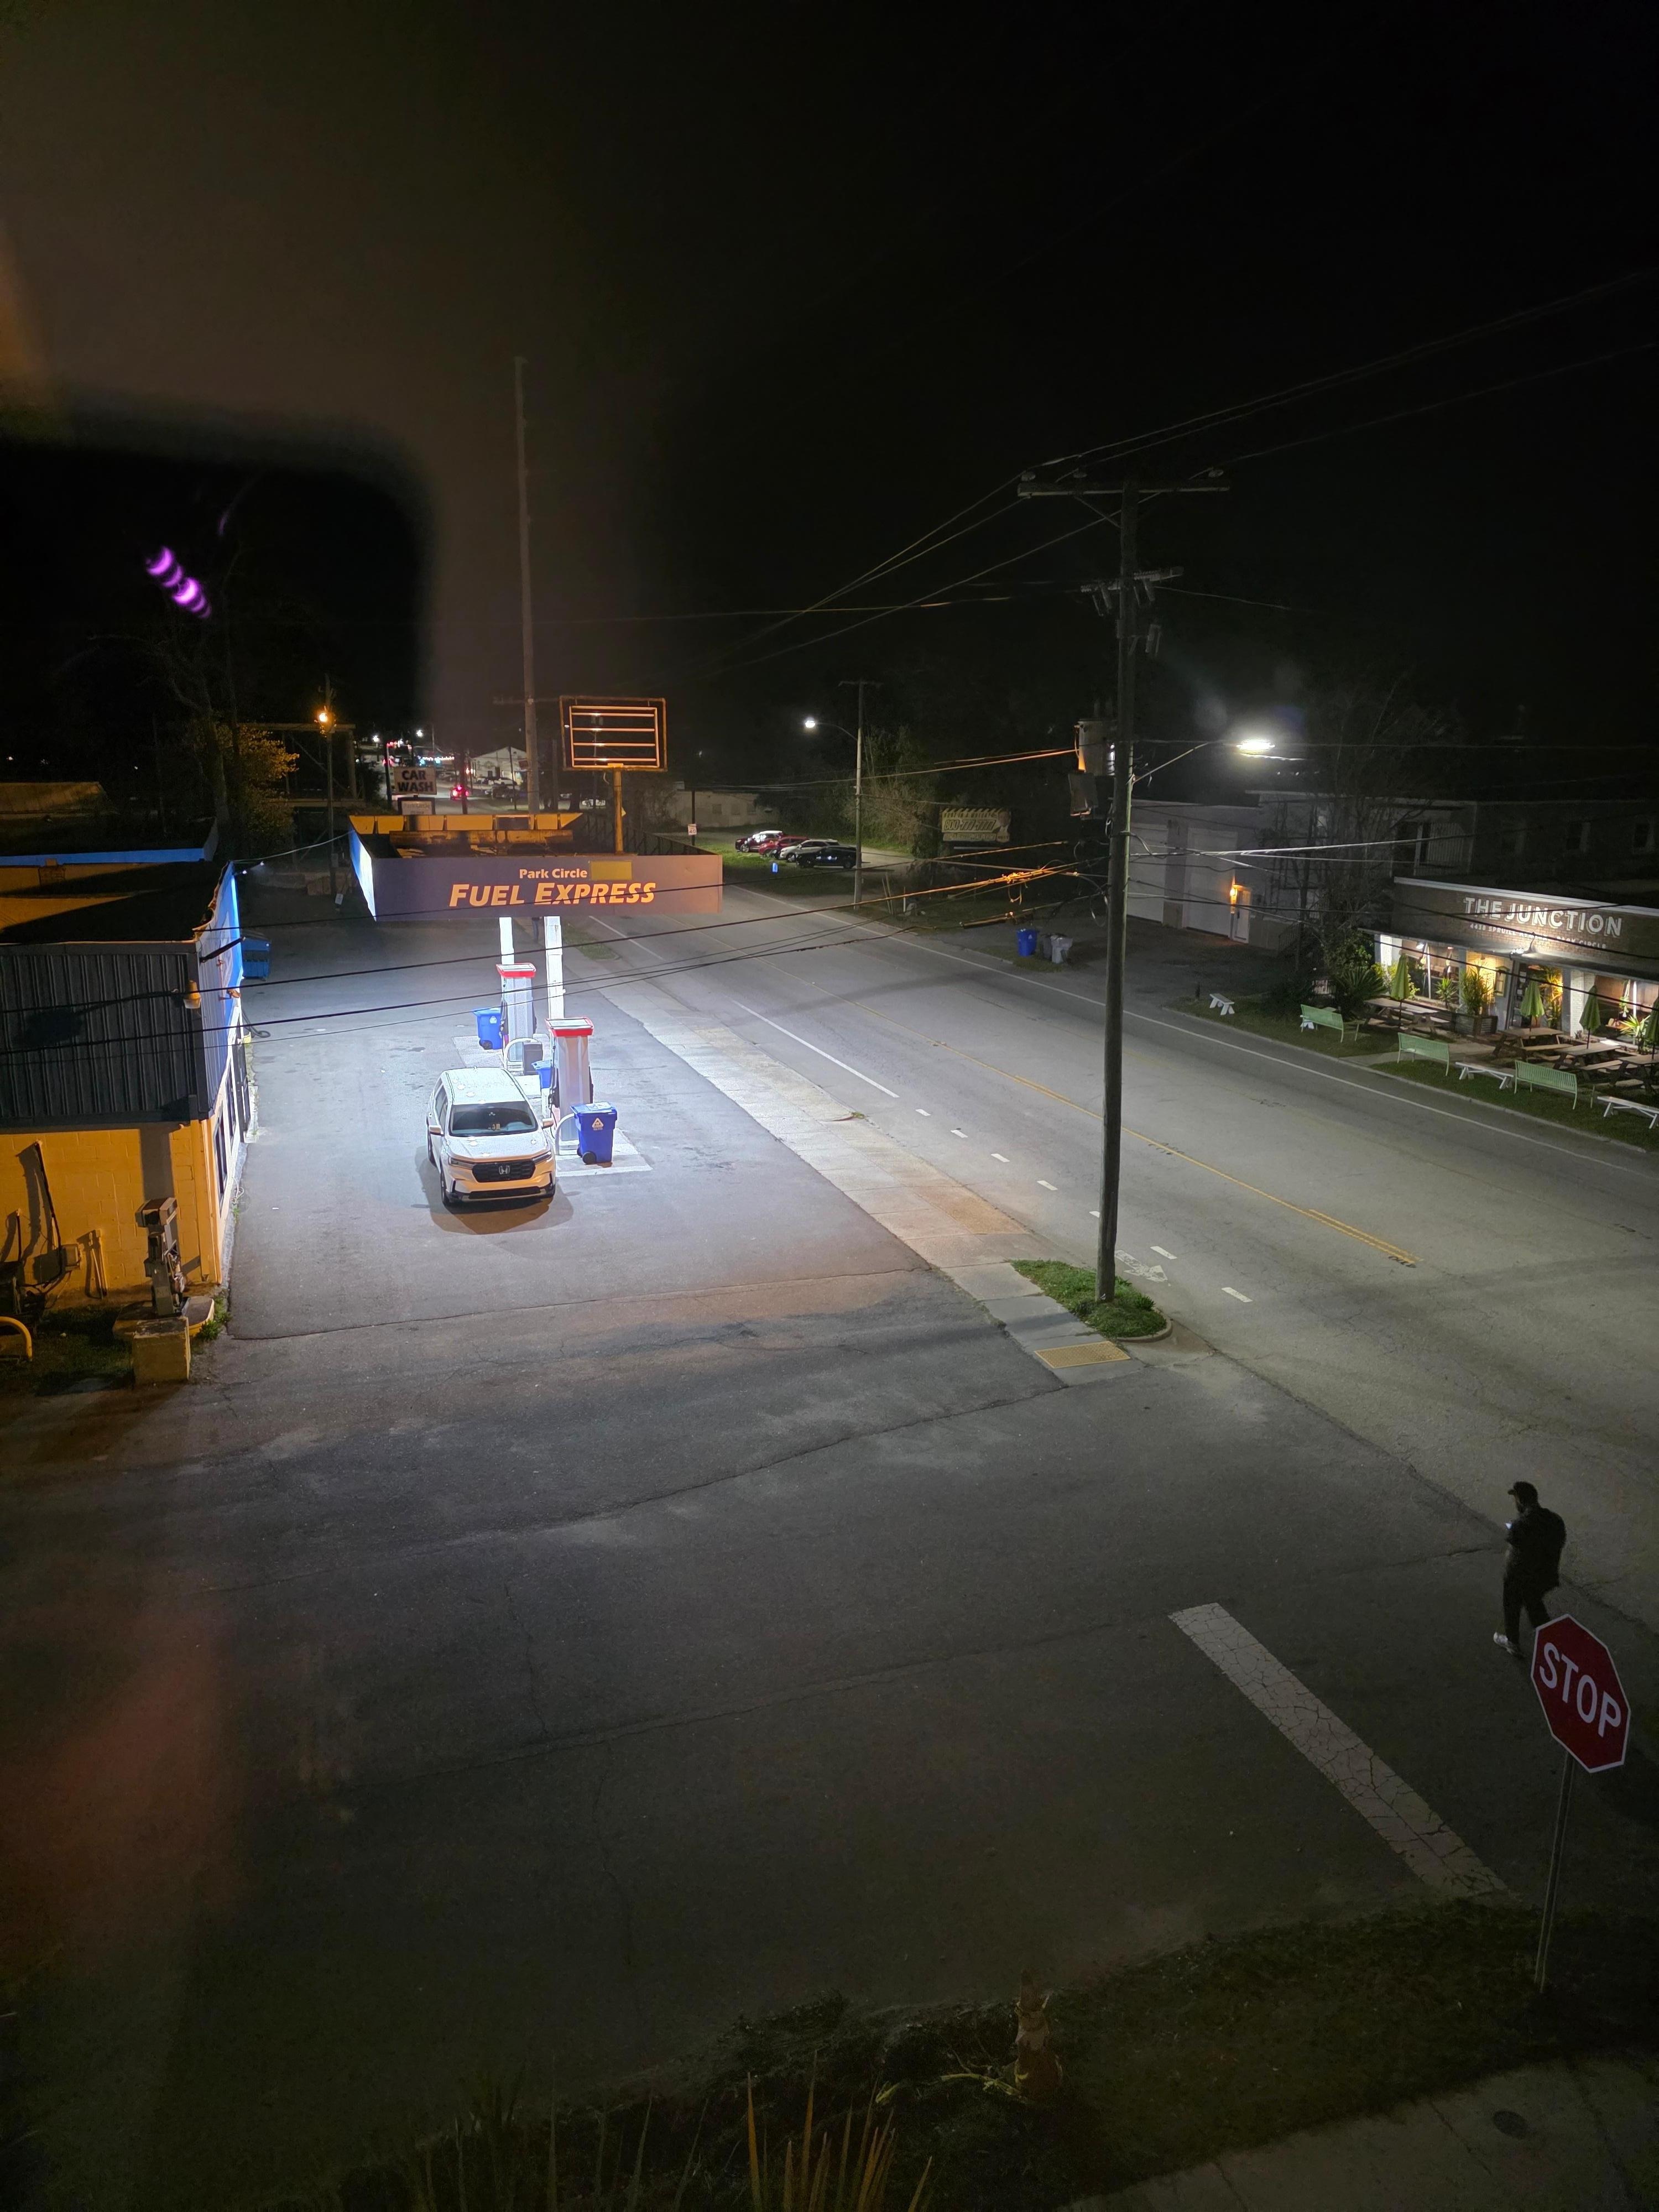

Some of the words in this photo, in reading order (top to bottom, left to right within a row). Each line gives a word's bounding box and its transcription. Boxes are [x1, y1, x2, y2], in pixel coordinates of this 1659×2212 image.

[402, 770, 426, 780] CAR
[397, 781, 434, 792] WASH
[519, 869, 549, 879] Park
[552, 868, 587, 878] Circle
[449, 884, 525, 907] FUEL
[534, 882, 656, 905] EXPRESS
[1464, 897, 1503, 920] THE
[1504, 902, 1622, 938] JUNCTION
[1540, 1642, 1621, 1738] STOP
